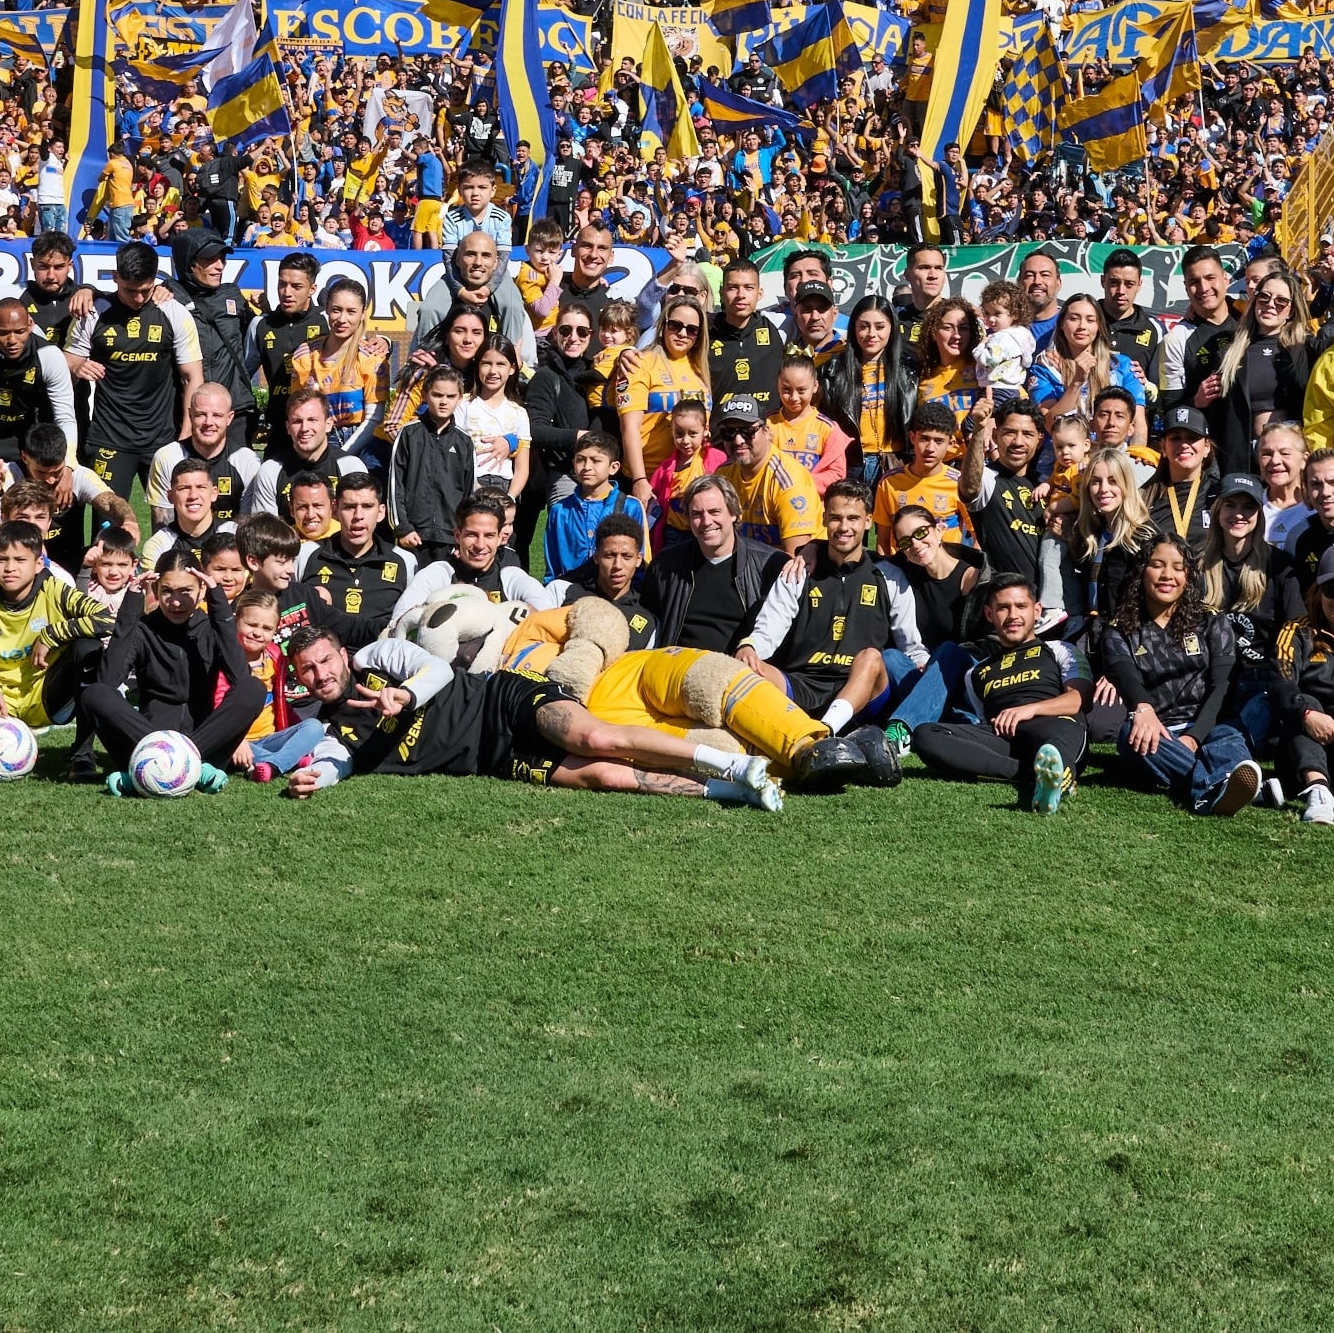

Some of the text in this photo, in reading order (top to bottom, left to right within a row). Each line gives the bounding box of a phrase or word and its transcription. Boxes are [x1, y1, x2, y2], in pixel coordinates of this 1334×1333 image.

[617, 3, 644, 20] CON
[647, 7, 667, 22] LA
[671, 8, 688, 23] FE
[274, 7, 584, 52] ESCOBEO
[121, 351, 158, 363] CEMEX
[723, 401, 753, 413] Jeep
[1233, 477, 1254, 487] TIGRES
[992, 668, 1041, 689] CEMEX
